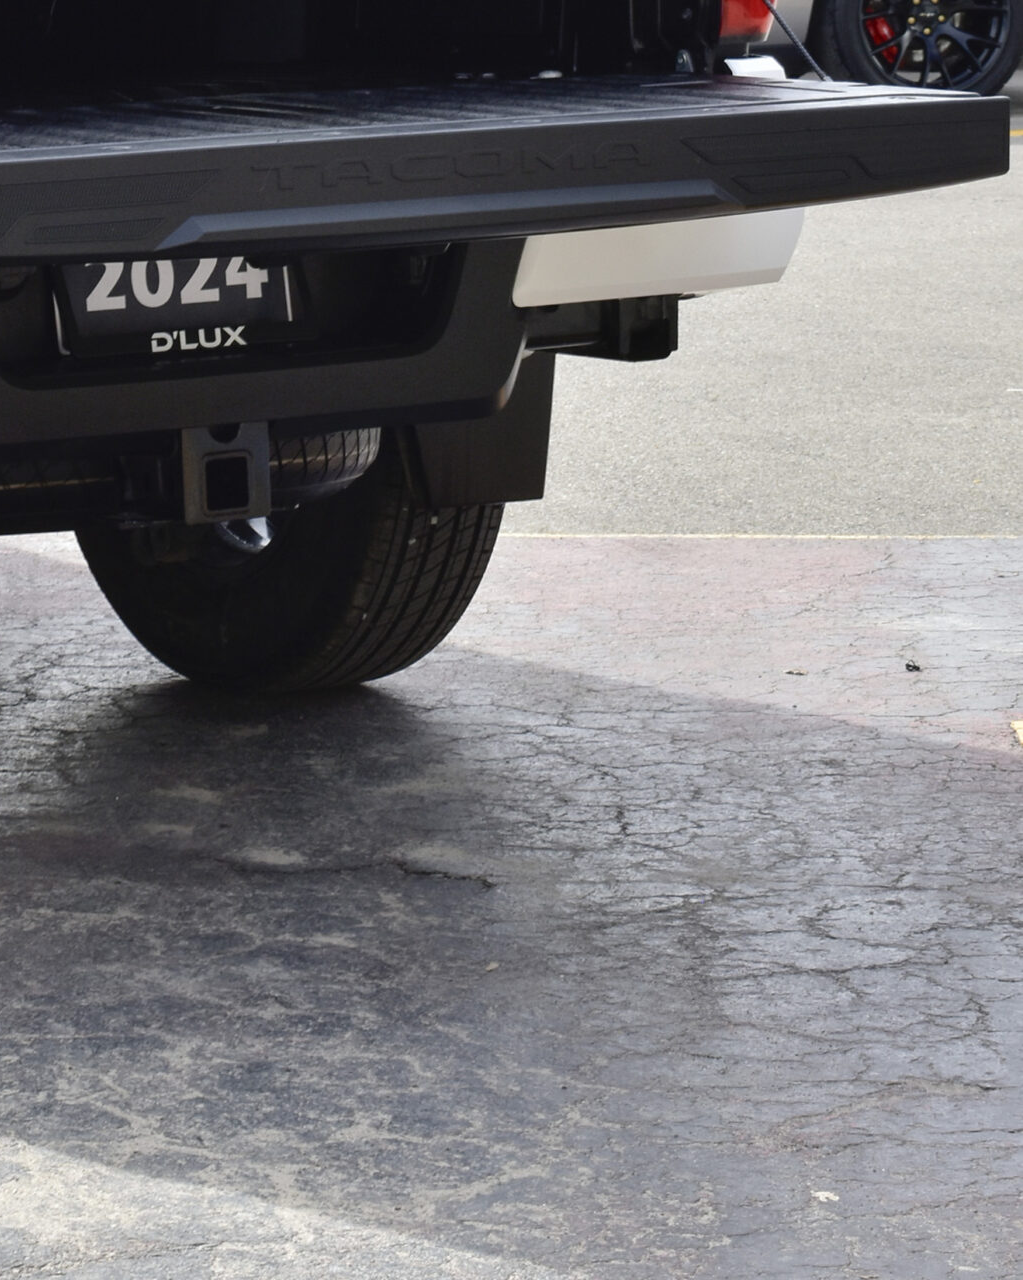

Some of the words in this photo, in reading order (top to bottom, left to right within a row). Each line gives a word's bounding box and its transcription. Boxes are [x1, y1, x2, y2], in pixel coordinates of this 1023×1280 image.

[250, 140, 651, 192] TACOMA
[85, 256, 269, 312] 2024
[150, 325, 248, 353] D'LUX
